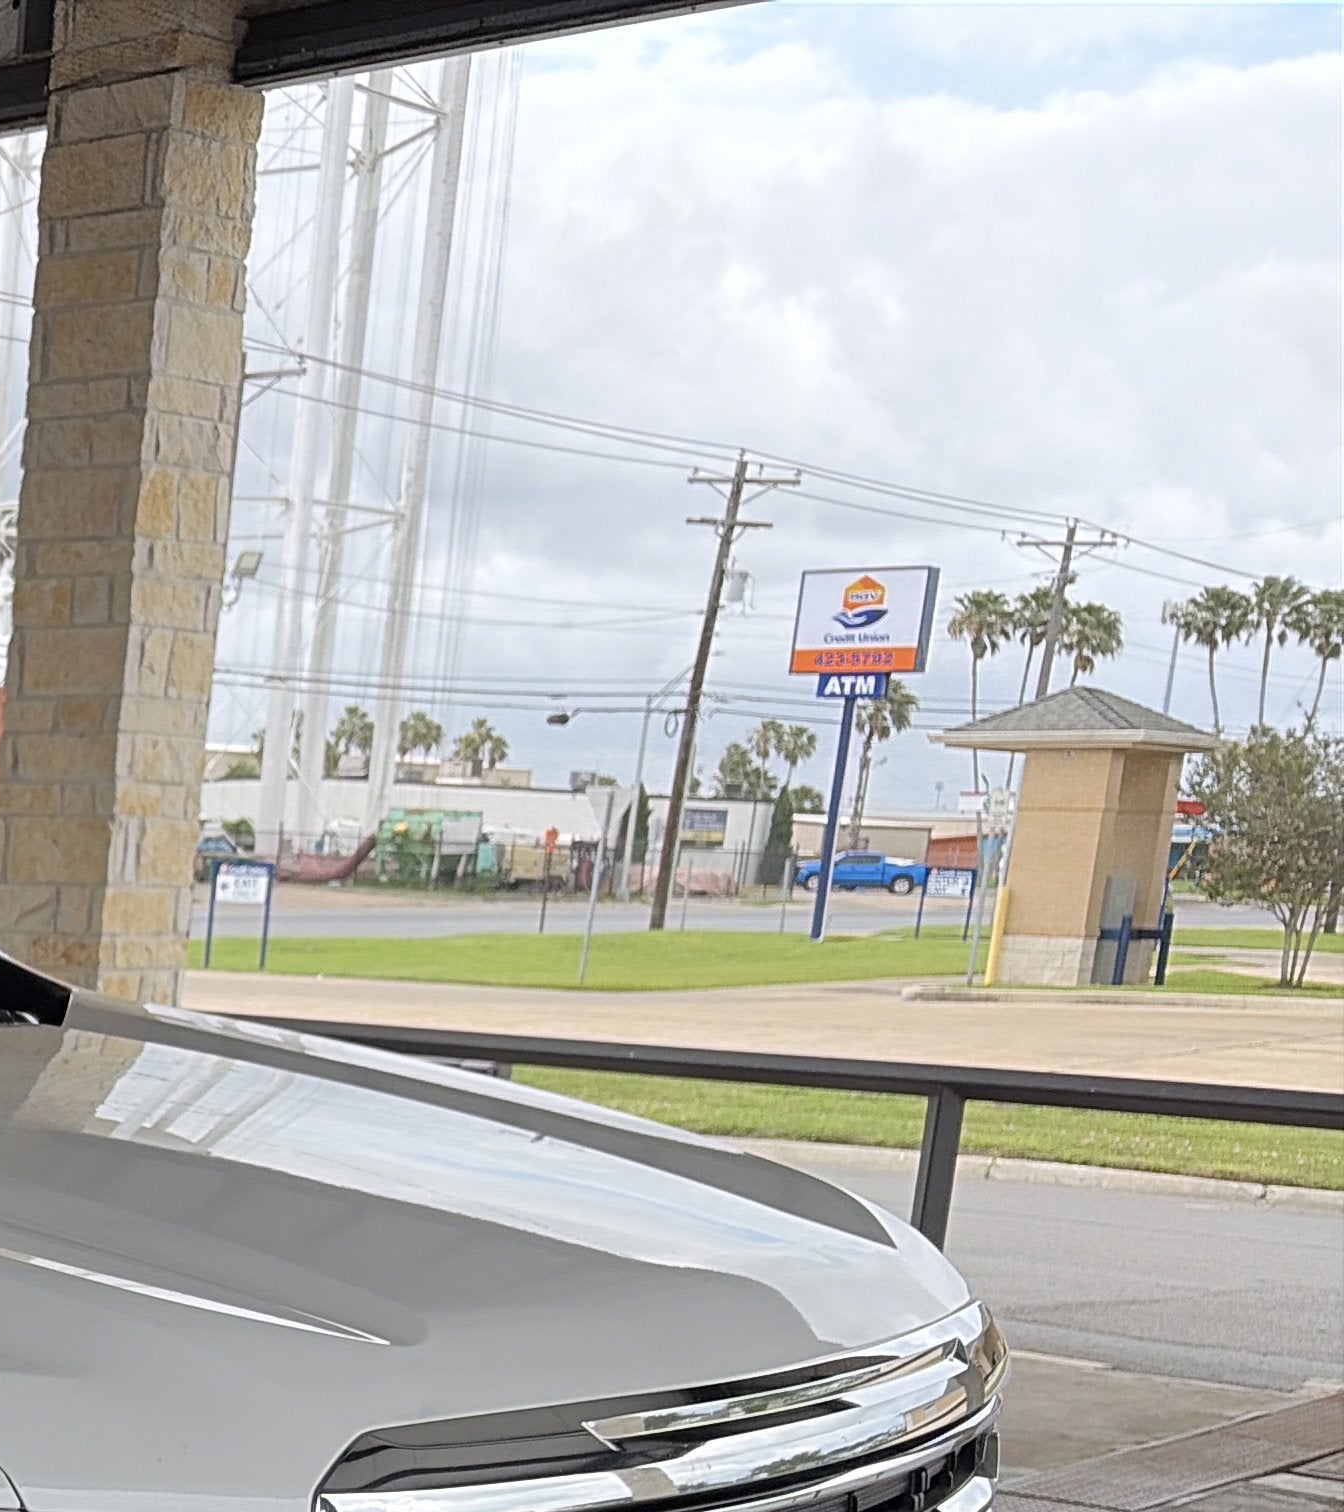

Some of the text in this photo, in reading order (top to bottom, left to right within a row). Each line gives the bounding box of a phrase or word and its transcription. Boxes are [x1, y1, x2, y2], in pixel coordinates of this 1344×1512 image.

[824, 632, 890, 645] Credit Union
[824, 674, 876, 696] ATM
